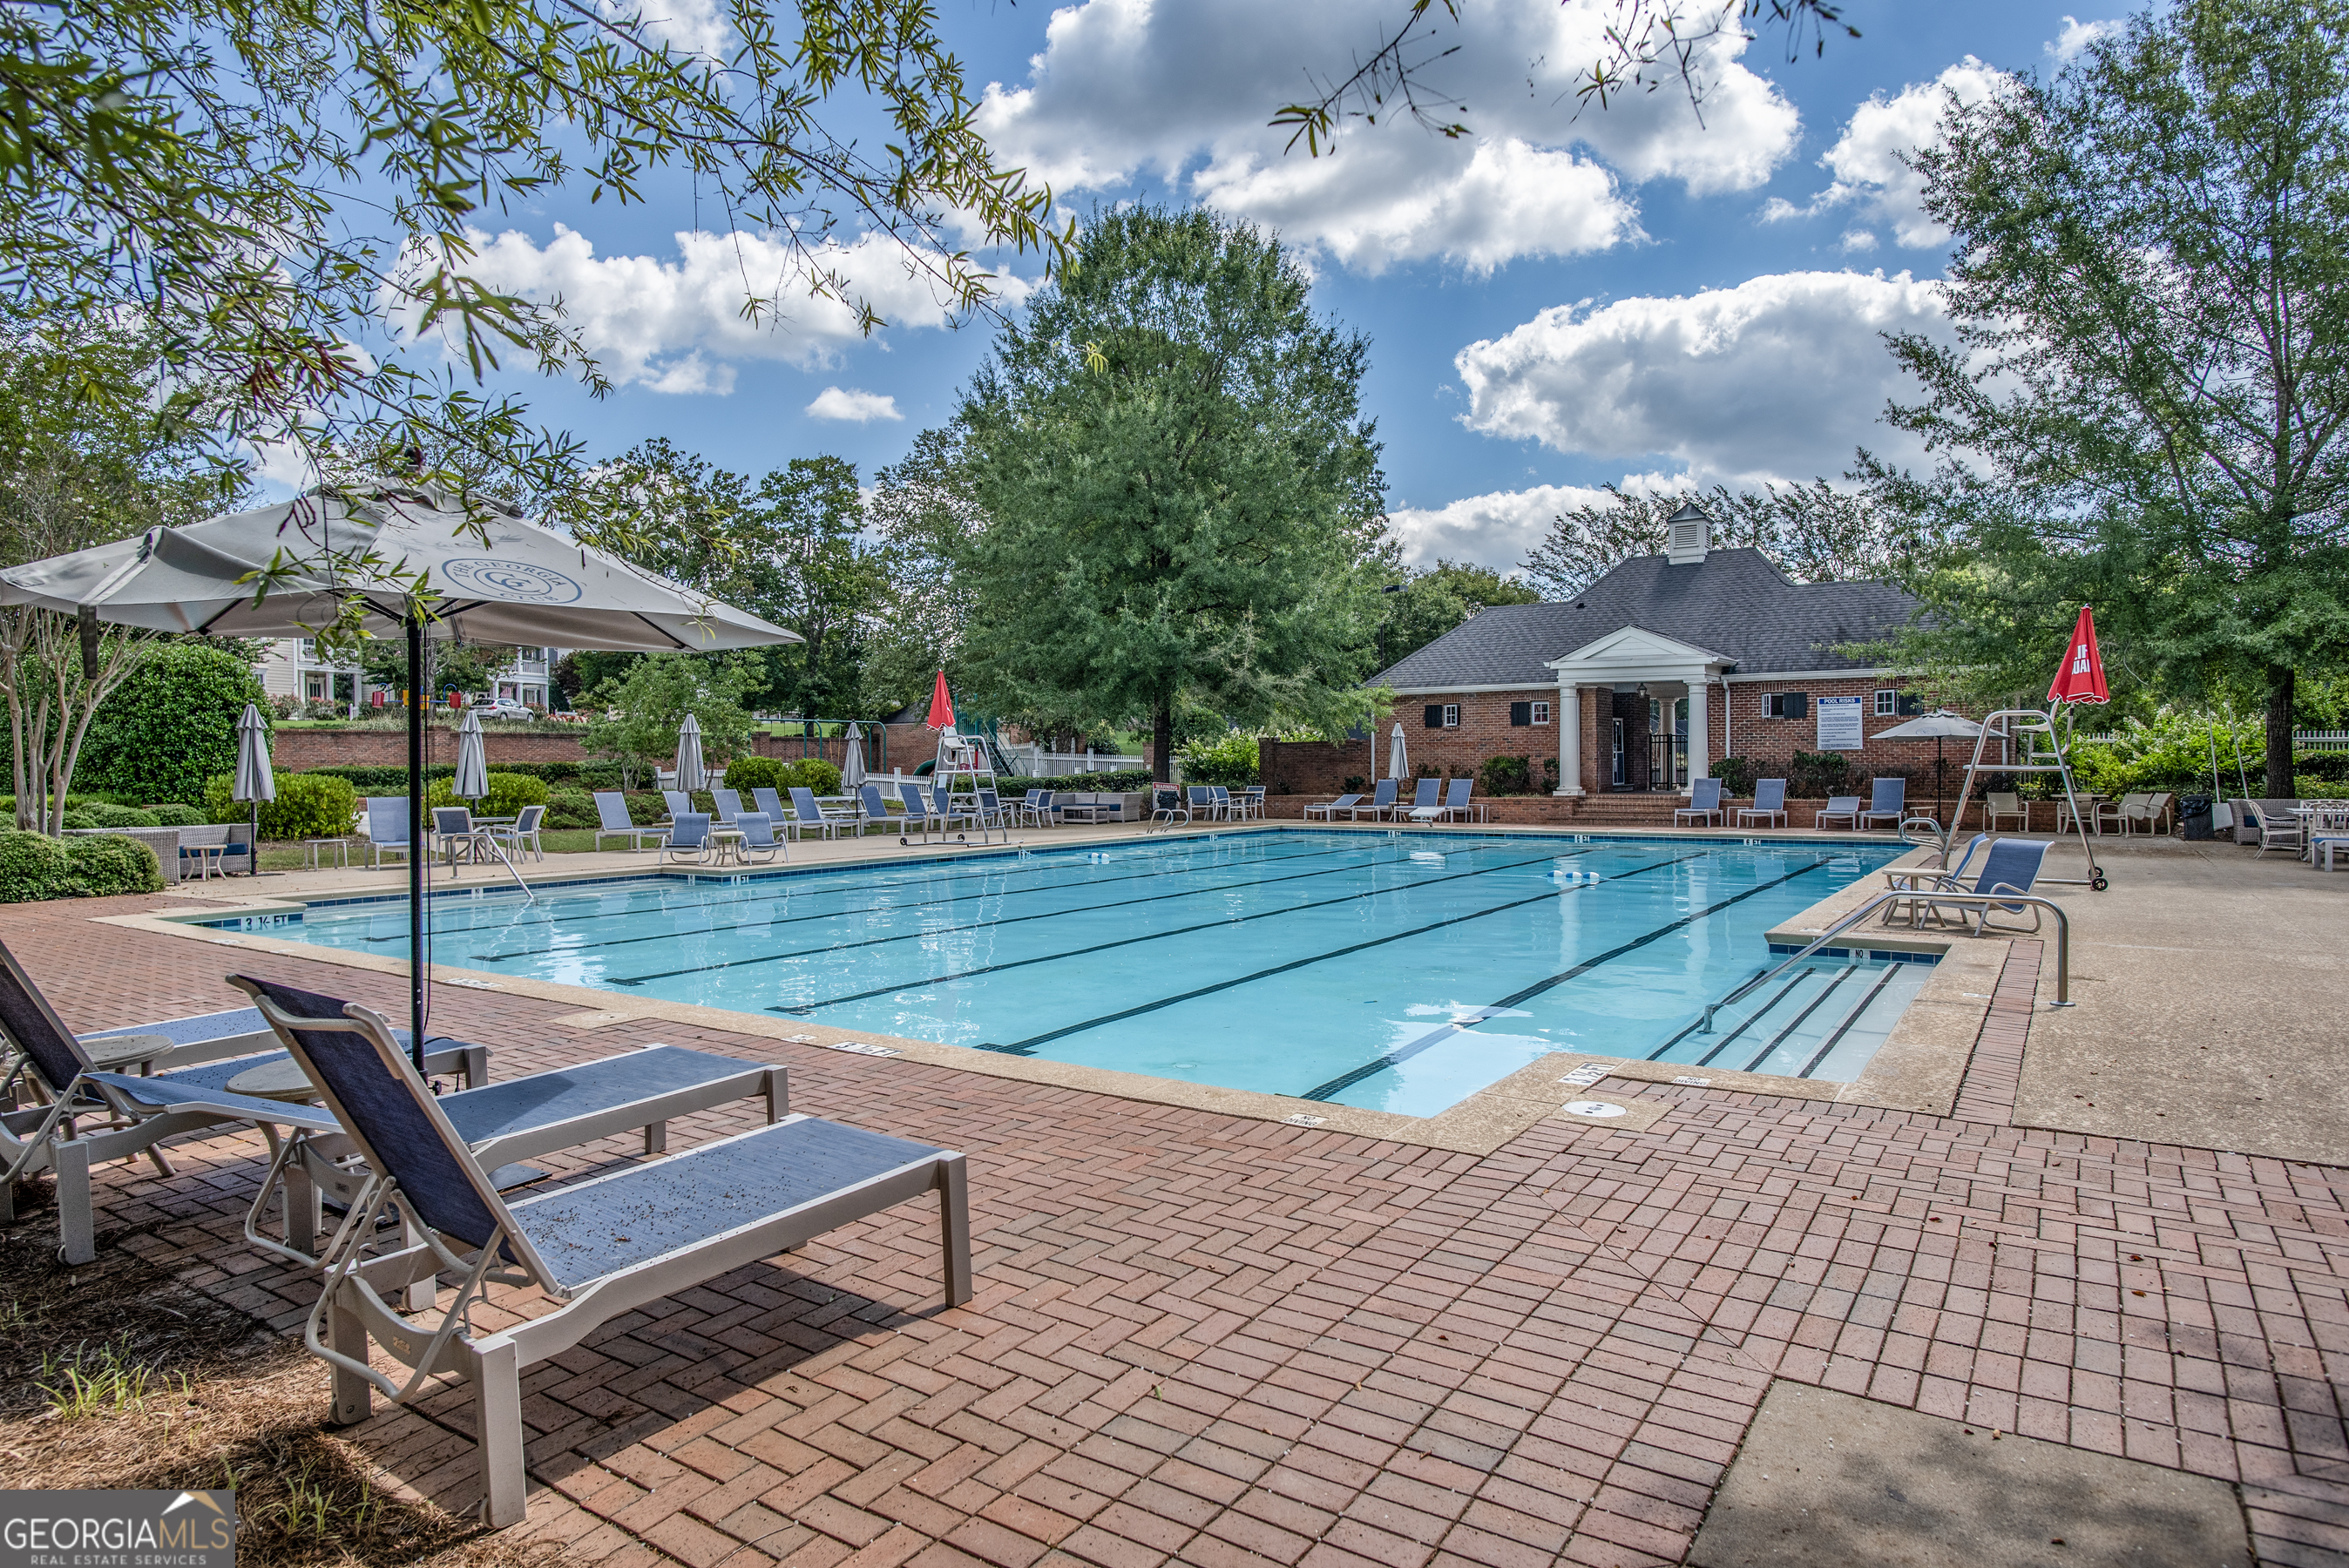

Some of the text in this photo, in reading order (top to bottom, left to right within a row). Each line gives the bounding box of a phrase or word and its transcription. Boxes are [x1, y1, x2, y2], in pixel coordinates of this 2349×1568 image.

[452, 561, 567, 587] THE GEORGIA
[499, 592, 559, 602] CLUB
[1855, 950, 1864, 959] NO
[1581, 1063, 1615, 1072] FT
[1283, 1118, 1317, 1126] DIVING
